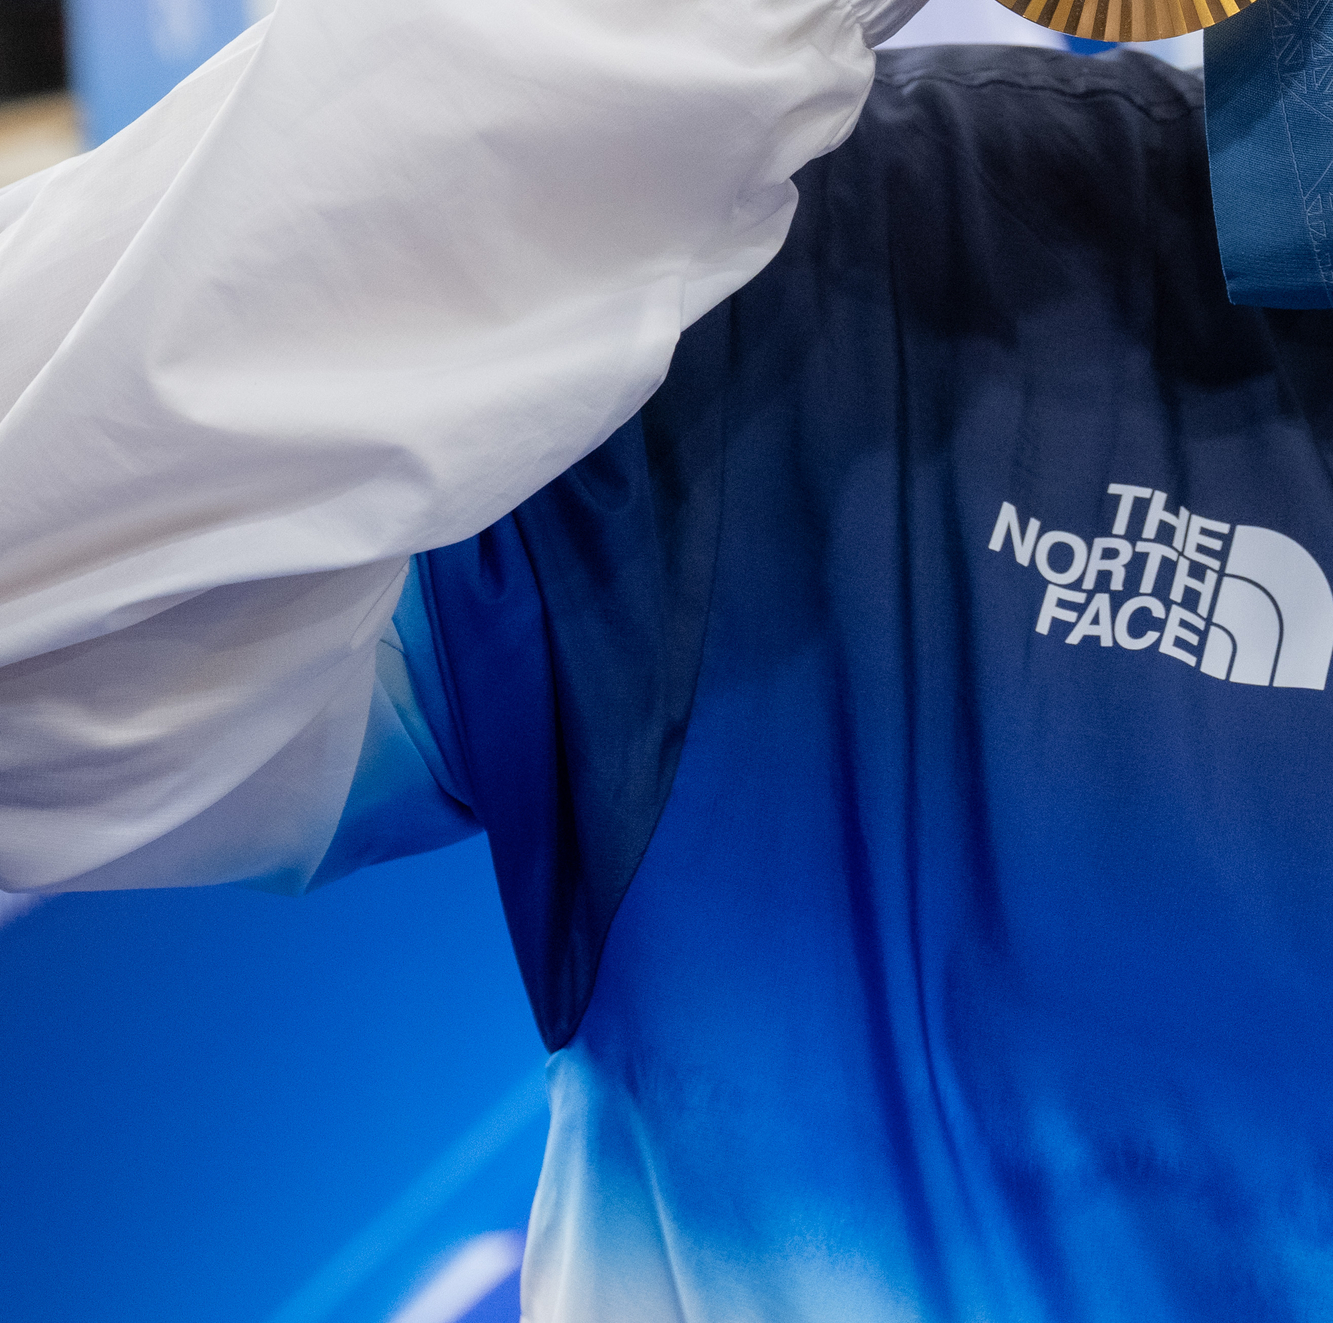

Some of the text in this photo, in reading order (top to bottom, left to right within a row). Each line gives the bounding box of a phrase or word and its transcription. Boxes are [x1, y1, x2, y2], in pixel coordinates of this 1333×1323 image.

[988, 501, 1218, 619] NORTH
[1107, 483, 1230, 572] THE
[1035, 583, 1206, 667] FACE
